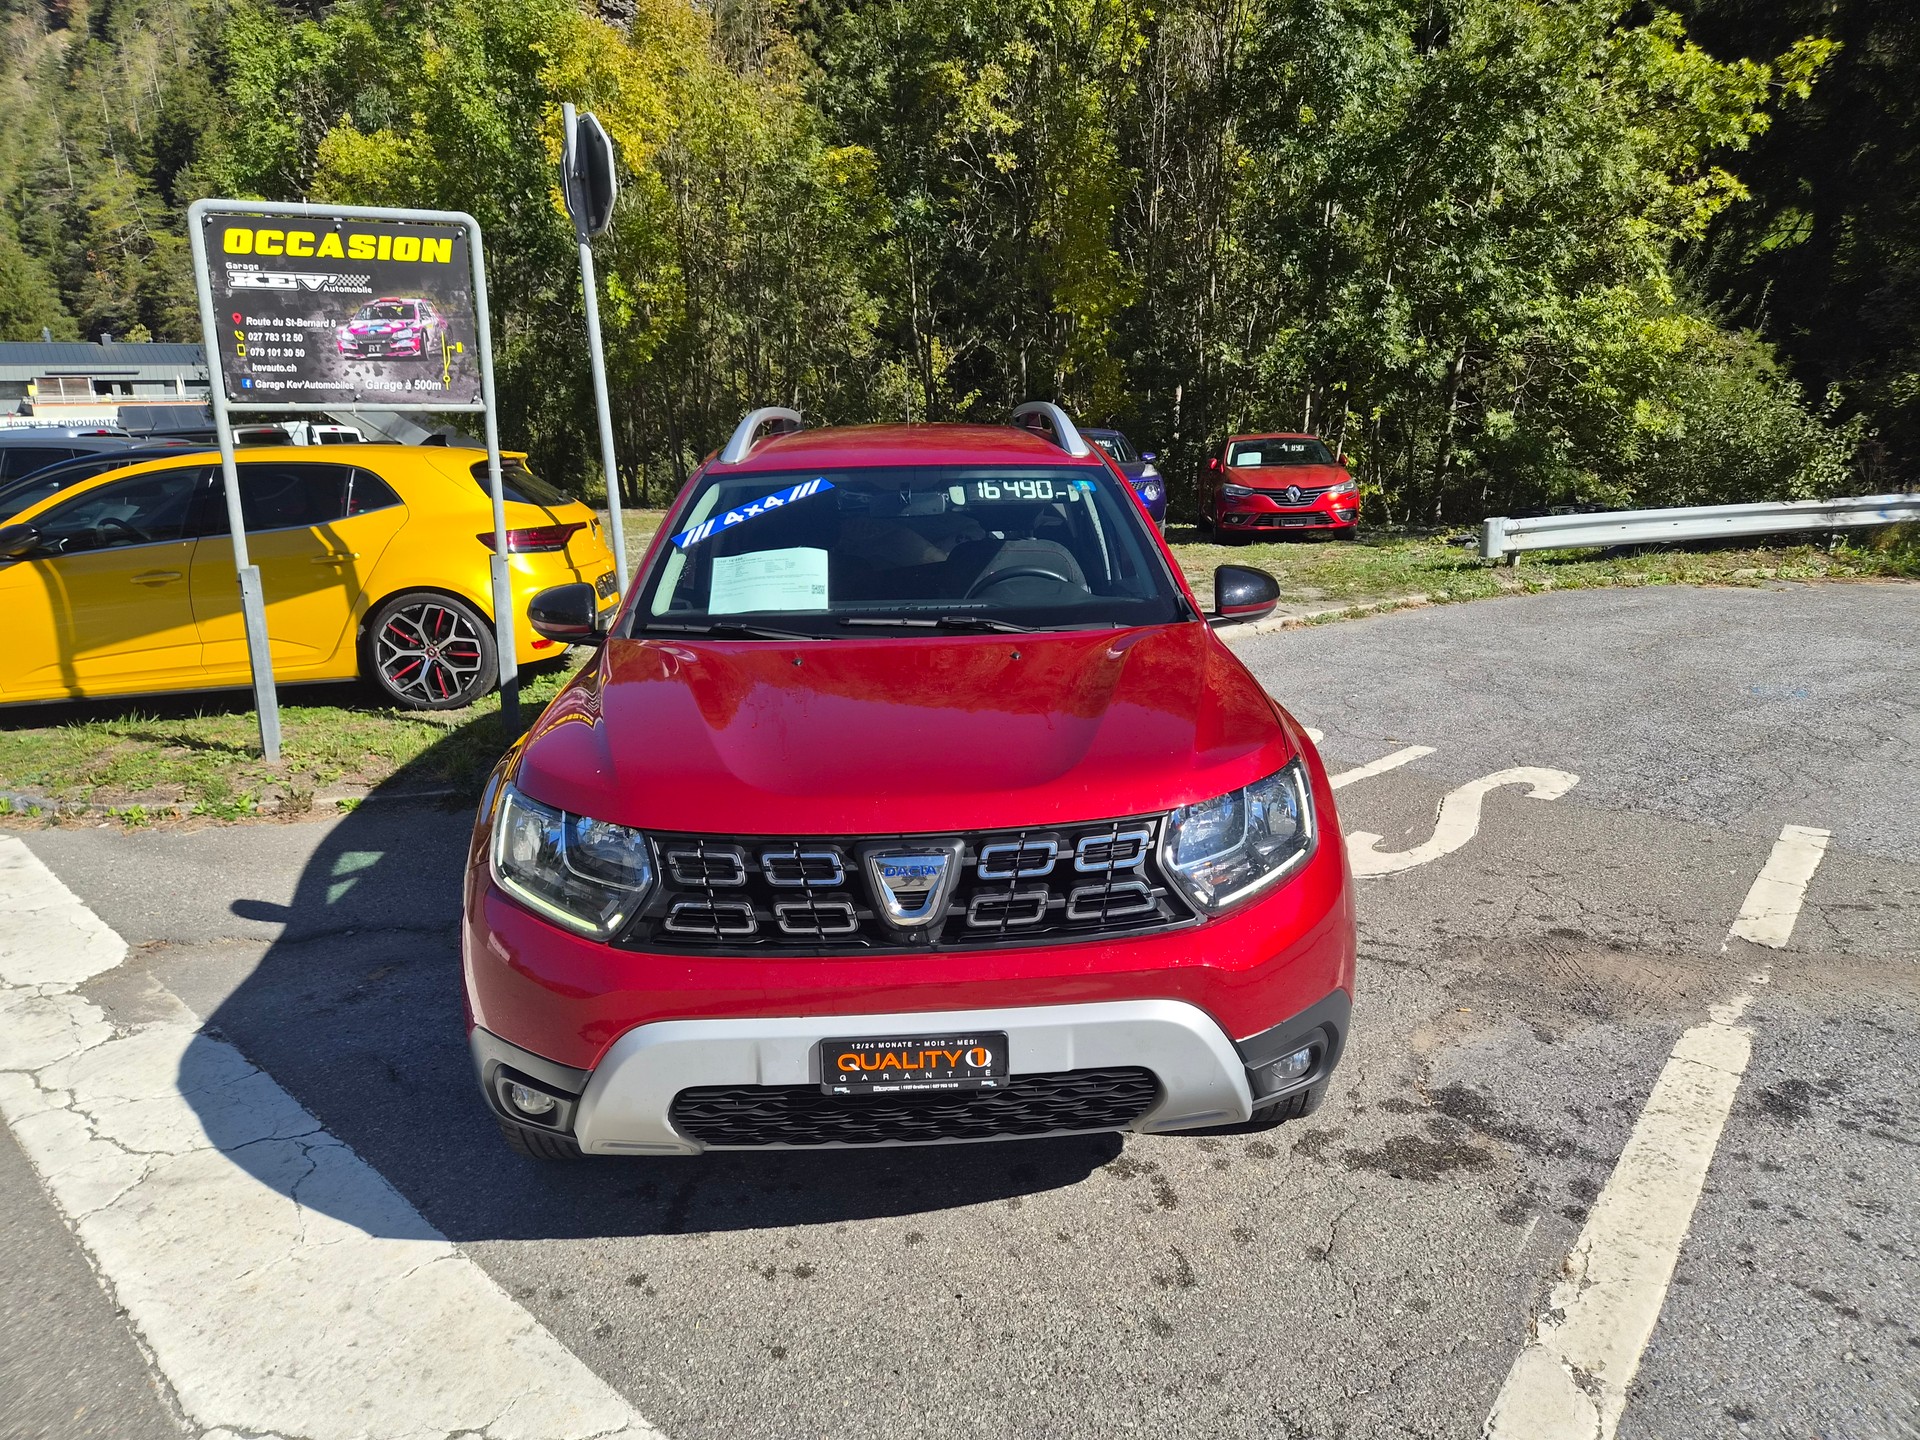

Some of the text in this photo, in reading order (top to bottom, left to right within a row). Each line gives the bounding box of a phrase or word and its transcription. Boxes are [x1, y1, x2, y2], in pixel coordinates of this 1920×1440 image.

[223, 228, 453, 263] OCCASION
[225, 262, 260, 271] Garage
[322, 285, 373, 294] Automobile
[246, 317, 271, 326] Route
[272, 317, 284, 327] du
[285, 318, 330, 328] St-Bernard
[248, 332, 304, 343] 027 783 12 50
[250, 348, 306, 358] 079 101 30 50
[368, 344, 381, 353] RT
[252, 363, 298, 373] kevauto.ch
[255, 380, 285, 391] Garage
[365, 379, 442, 392] Garage à 500m
[723, 496, 785, 525] 4x4
[884, 865, 937, 877] DACIA
[924, 1040, 946, 1048] MOIS
[837, 1049, 963, 1072] QUALITY
